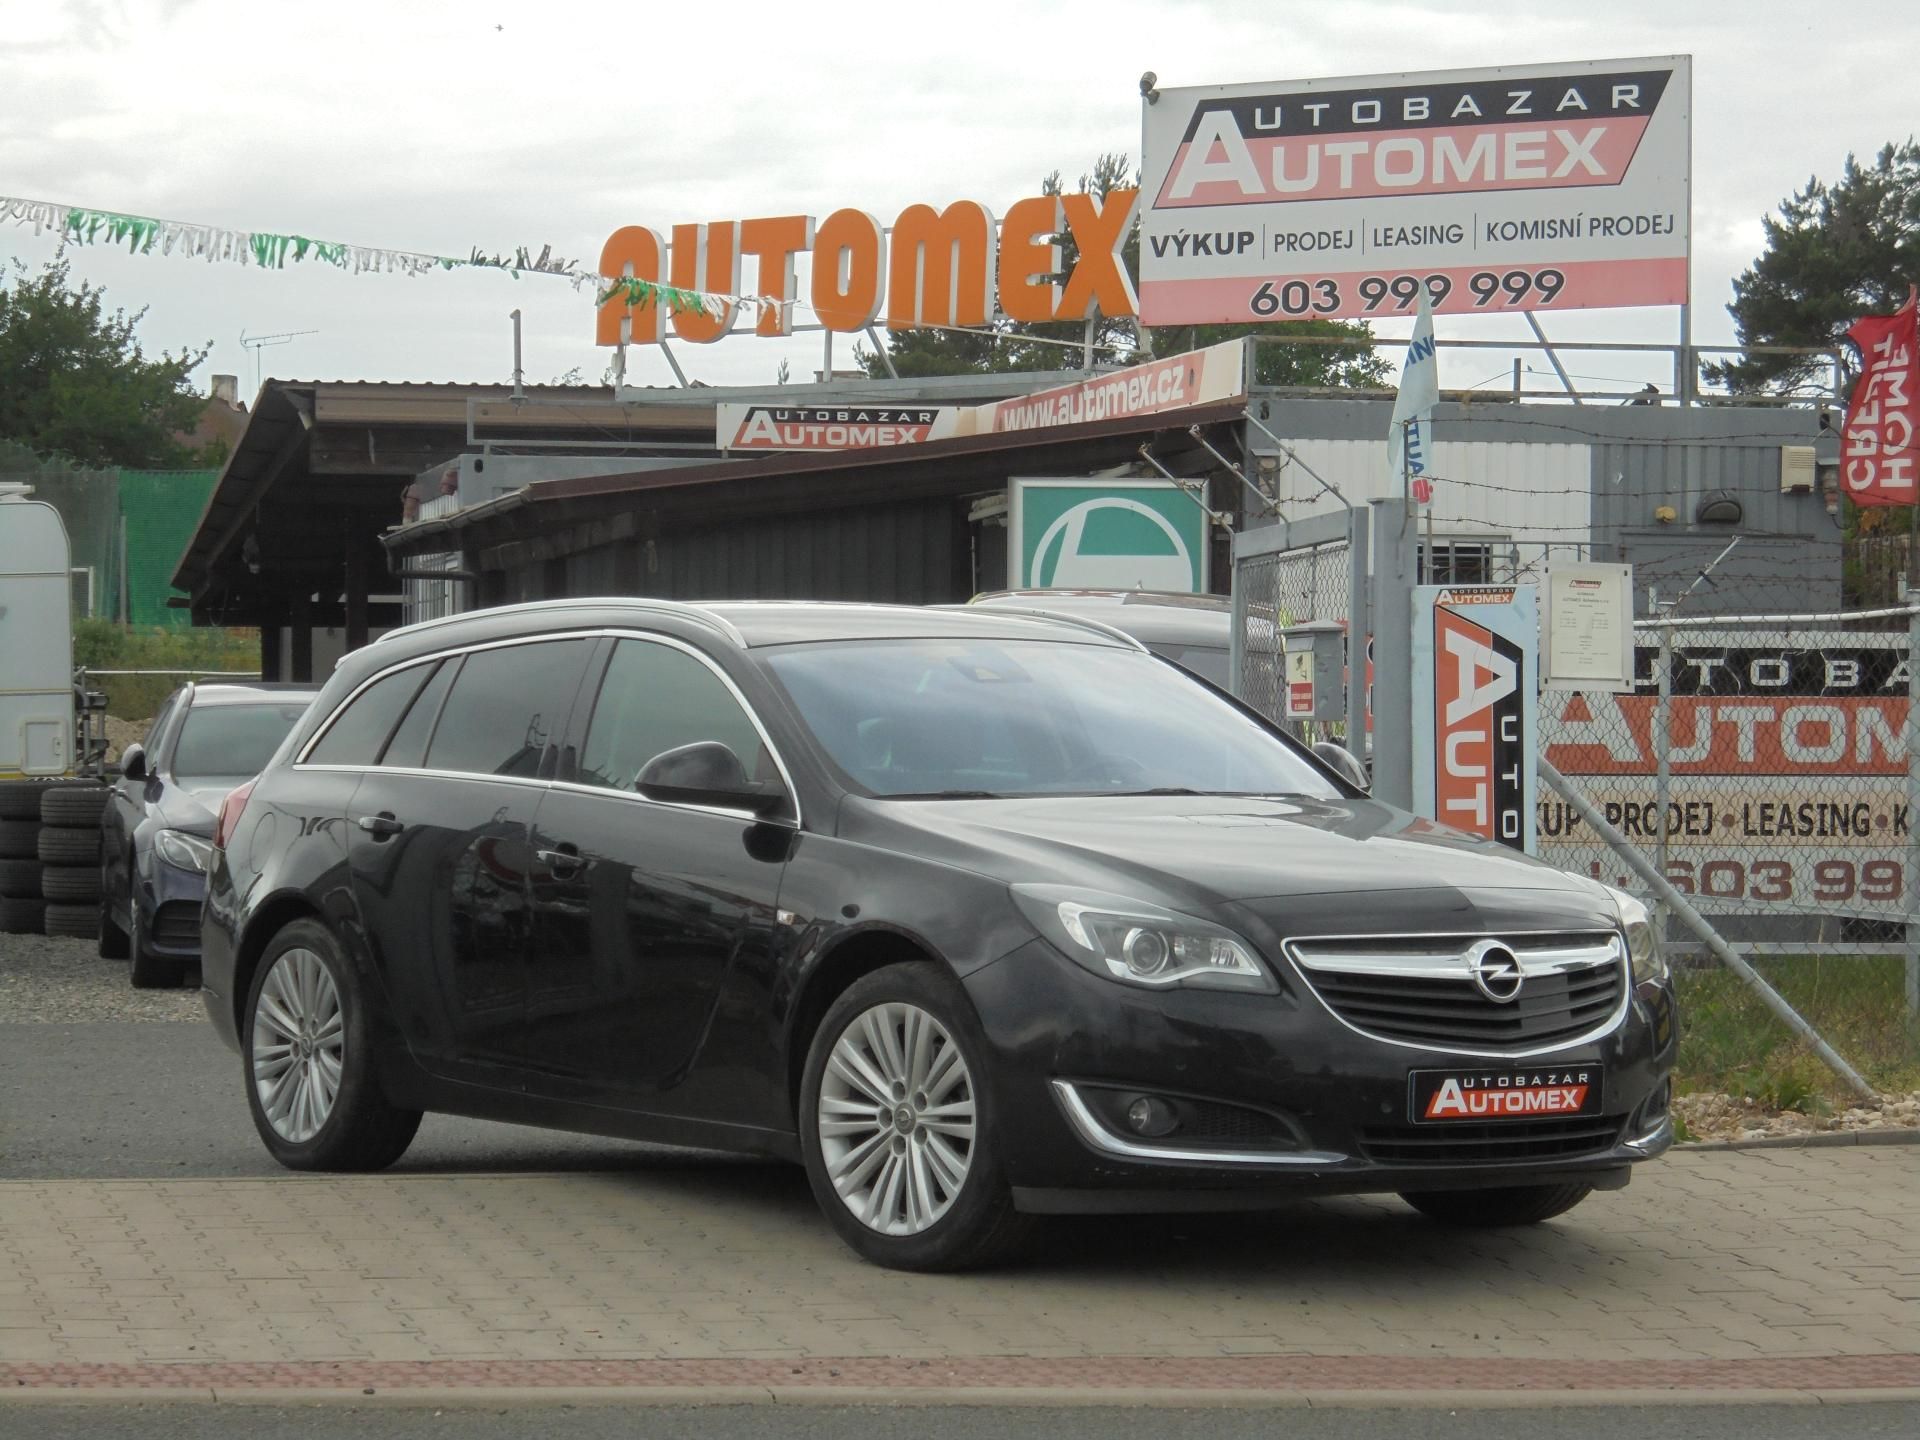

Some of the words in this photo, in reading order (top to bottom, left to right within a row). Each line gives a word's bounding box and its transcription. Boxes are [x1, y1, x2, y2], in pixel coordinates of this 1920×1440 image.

[1168, 109, 1608, 199] AUTOMEX
[1150, 228, 1255, 258] VÝKUP
[1274, 230, 1354, 252] PRODEJ
[1373, 224, 1464, 247] LEASING
[1486, 212, 1583, 242] KOMISNÍ
[1589, 214, 1674, 237] PRODEJ
[596, 190, 1140, 347] AUTOMEX
[1250, 279, 1342, 317] 603
[1358, 273, 1452, 312] 999
[1468, 268, 1566, 307] 999
[1003, 365, 1185, 432] www.automex.cz
[740, 410, 920, 446] AUTOMEX
[1436, 589, 1510, 604] AUTOMEX
[1605, 802, 1714, 837] PRODEJ
[1742, 802, 1870, 838] LEASING
[1431, 1078, 1579, 1114] AUTOMEX
